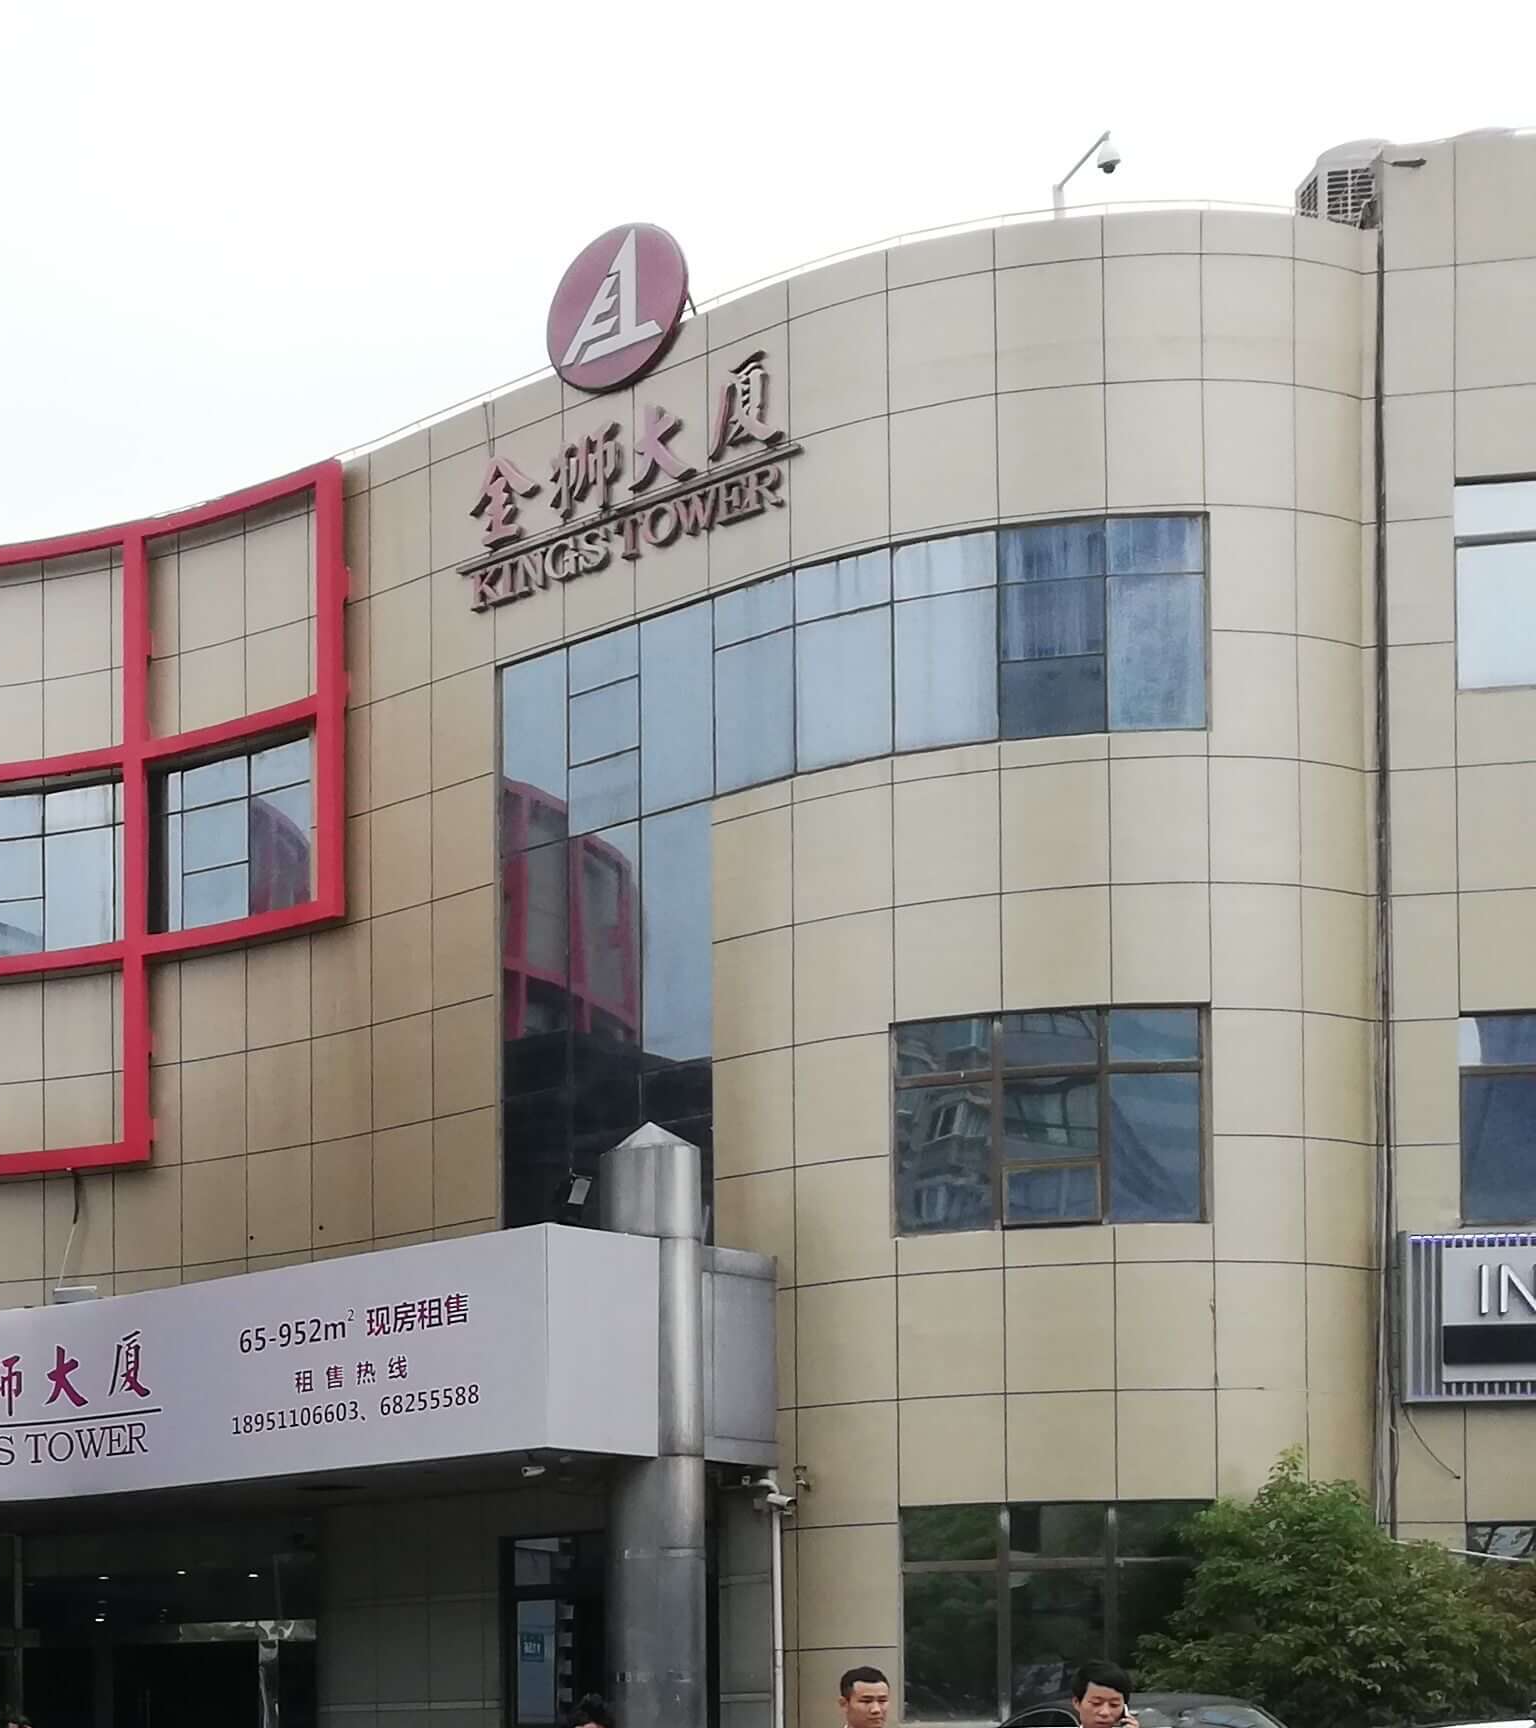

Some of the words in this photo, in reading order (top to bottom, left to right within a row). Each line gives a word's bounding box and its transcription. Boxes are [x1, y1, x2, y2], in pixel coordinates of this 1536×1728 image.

[471, 528, 611, 613] KINGS
[615, 463, 786, 561] TOWER
[366, 1292, 470, 1337] 现房租售
[294, 1354, 409, 1395] 租售热线
[24, 1421, 149, 1464] TOWER
